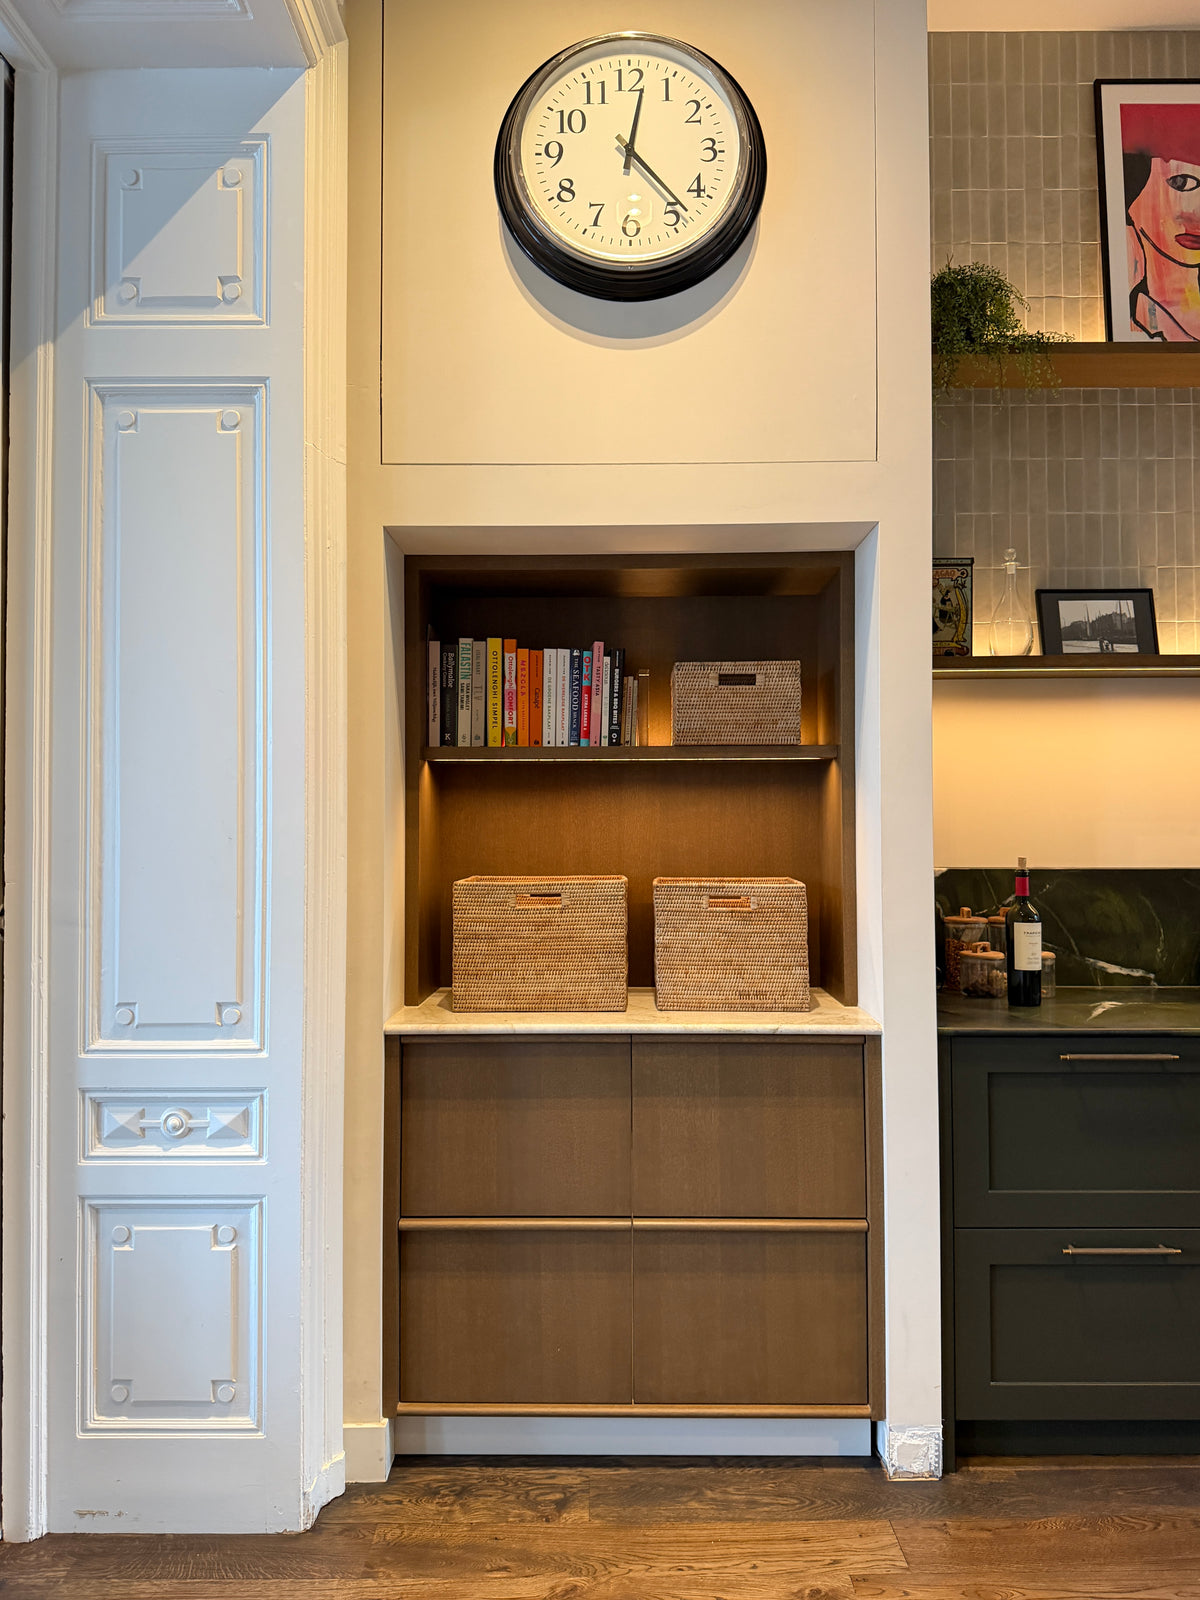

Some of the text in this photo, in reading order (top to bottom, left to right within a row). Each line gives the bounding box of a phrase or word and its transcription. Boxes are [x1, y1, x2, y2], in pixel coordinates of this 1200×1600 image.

[614, 67, 644, 92] 12
[661, 77, 673, 102] 1
[582, 80, 609, 105] 11
[556, 108, 587, 134] 10
[684, 99, 702, 125] 2
[544, 140, 564, 168] 9
[700, 137, 718, 162] 3
[556, 178, 576, 203] 8
[686, 173, 706, 198] 4
[589, 201, 605, 227] 7
[621, 214, 641, 237] 6
[663, 202, 681, 227] 5
[447, 652, 455, 688] Ballymaloe
[583, 656, 591, 681] OTK
